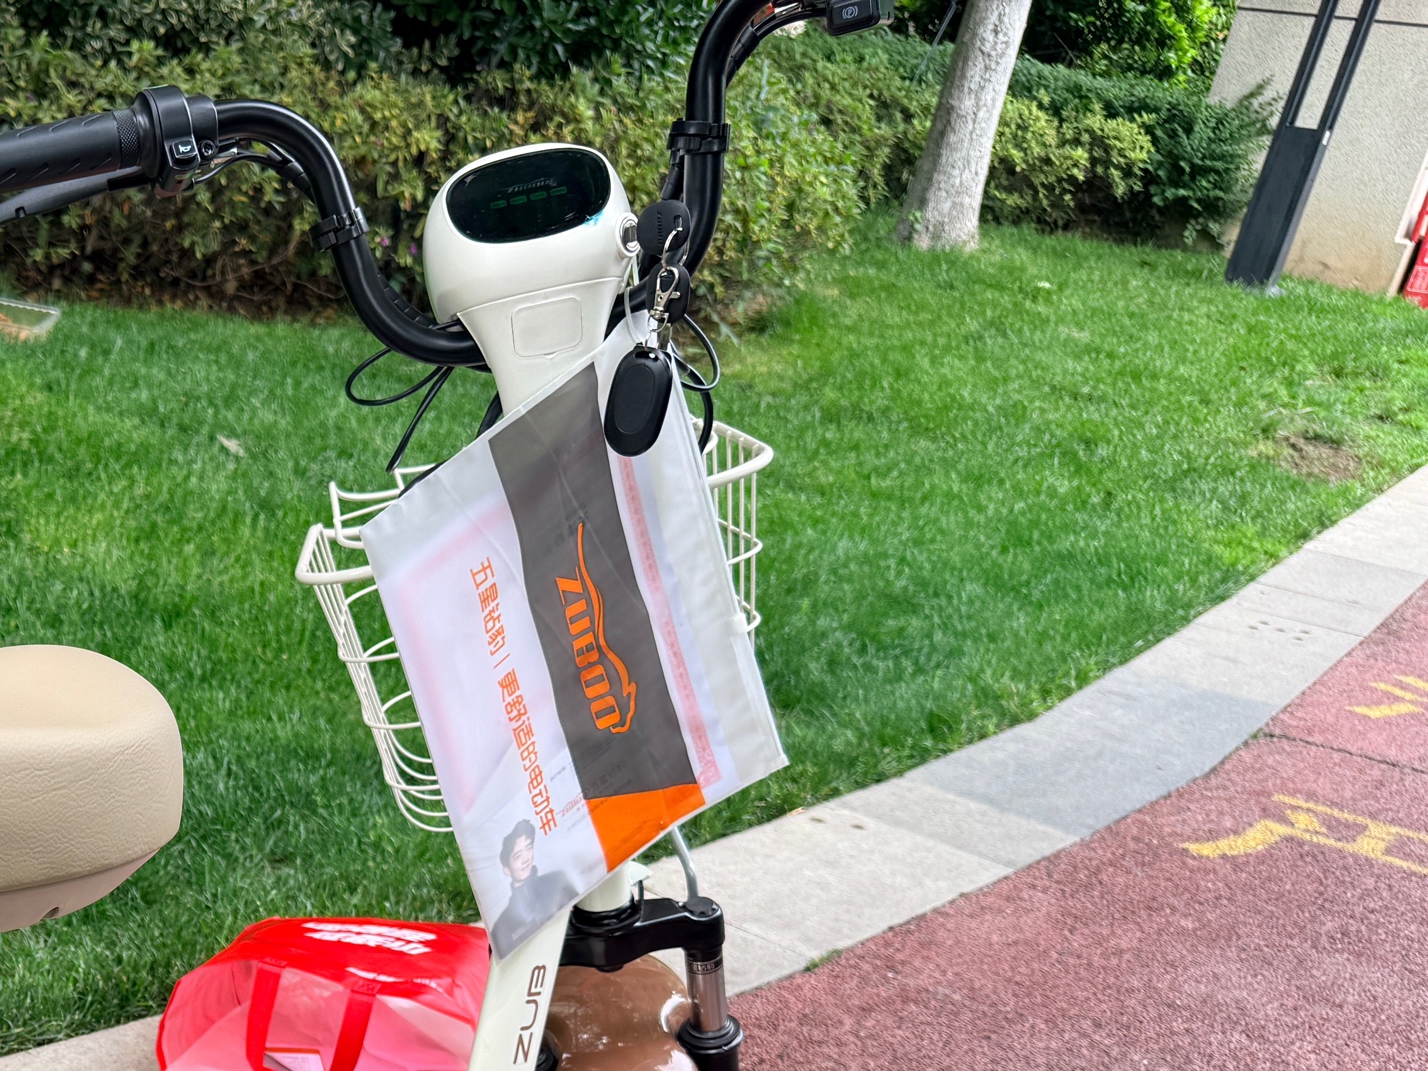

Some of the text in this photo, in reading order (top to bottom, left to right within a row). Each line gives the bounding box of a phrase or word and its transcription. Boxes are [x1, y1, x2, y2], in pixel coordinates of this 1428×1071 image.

[469, 556, 558, 837] 五星钻豹 更舒适的电动车
[555, 575, 621, 731] ZUBOO
[513, 963, 548, 1066] ZUB
